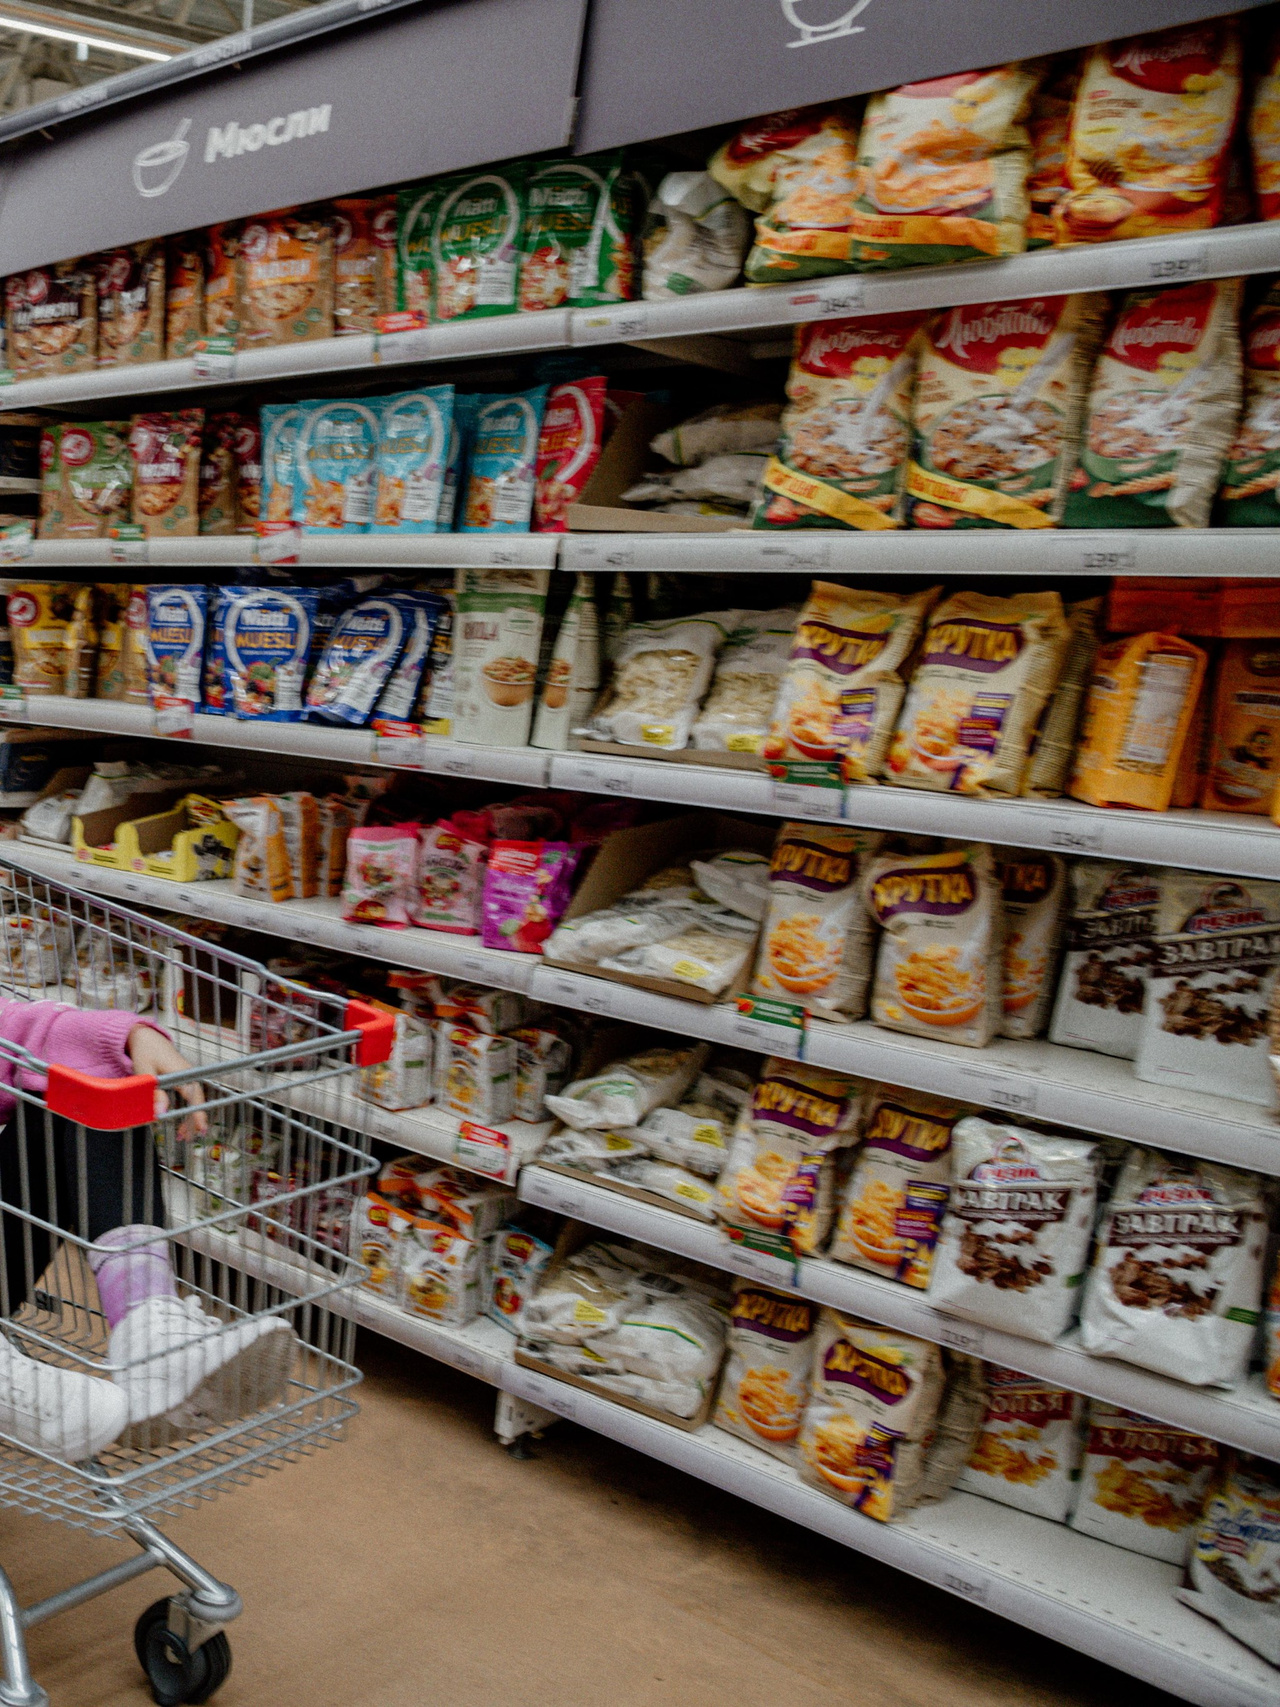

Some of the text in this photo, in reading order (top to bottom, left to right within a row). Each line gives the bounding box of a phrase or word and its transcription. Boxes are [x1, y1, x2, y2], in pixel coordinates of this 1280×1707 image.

[204, 104, 332, 163] Мюсли
[235, 631, 298, 650] MUESLI
[1113, 1211, 1241, 1237] ЗАВТРАК
